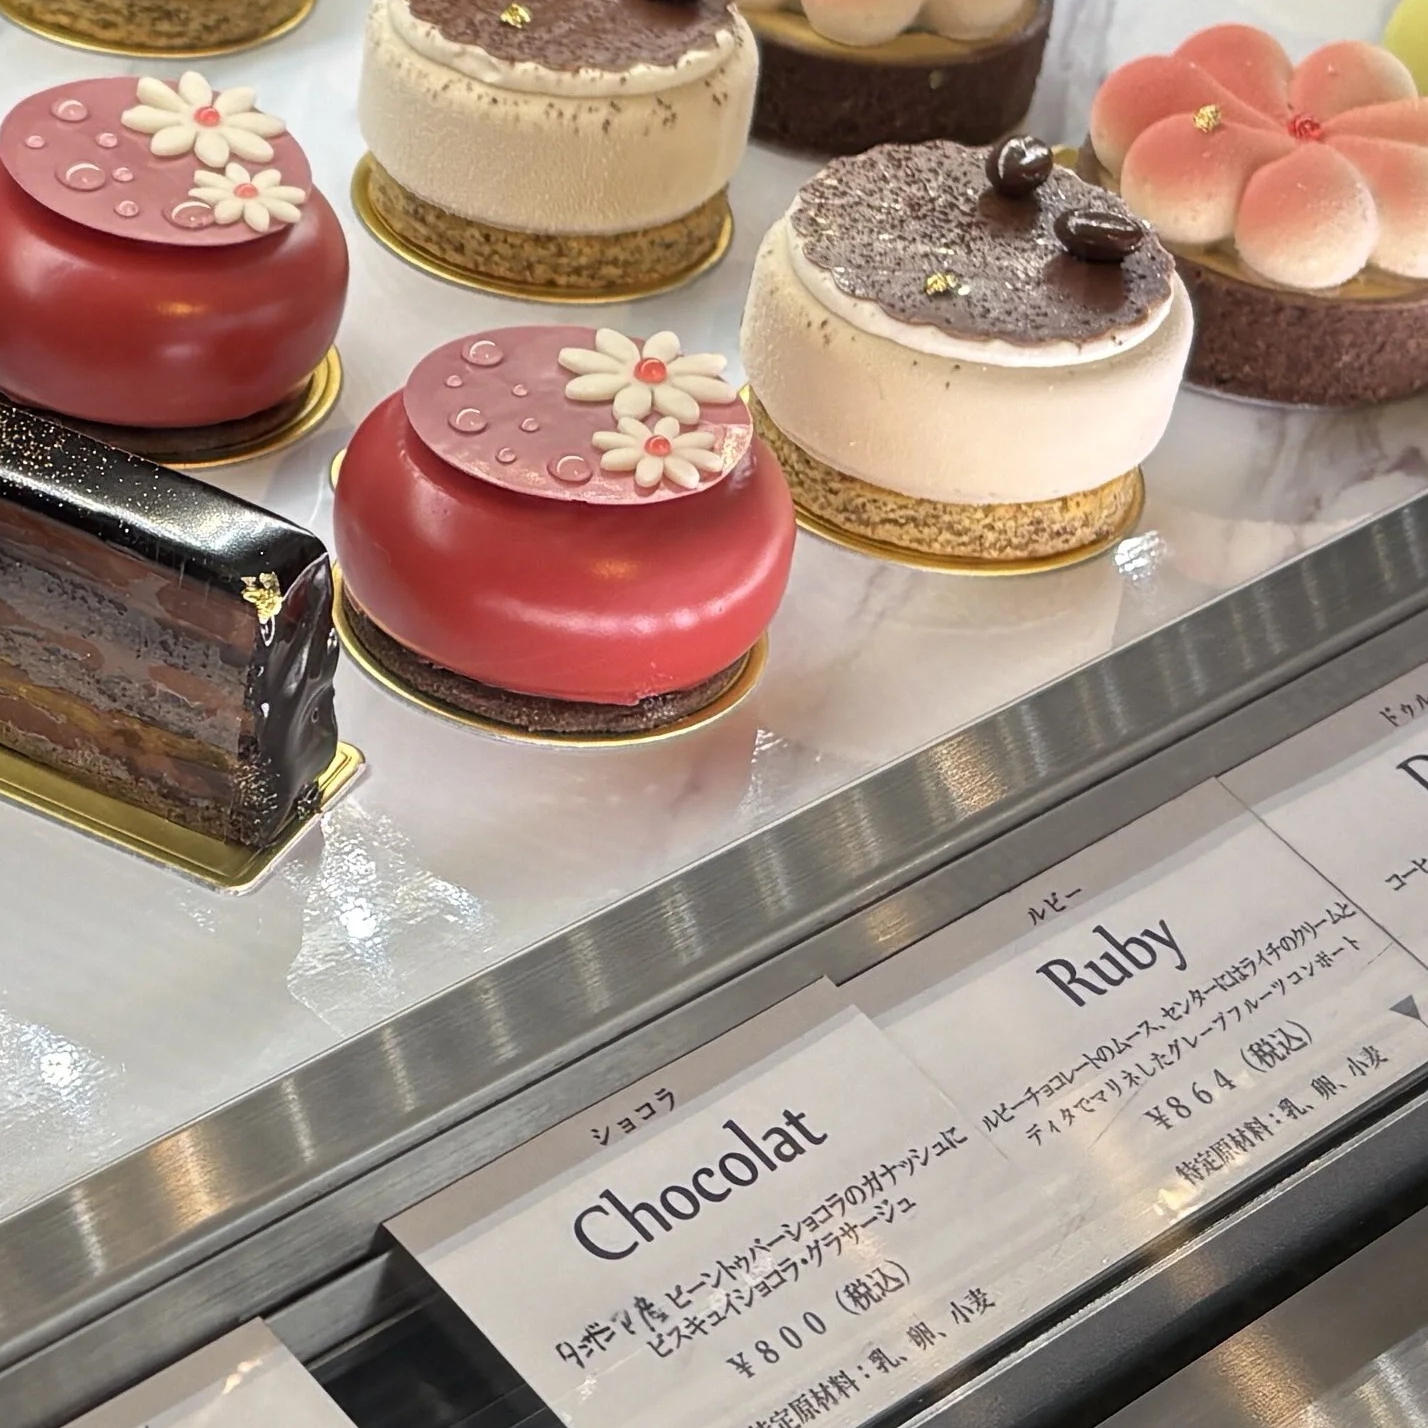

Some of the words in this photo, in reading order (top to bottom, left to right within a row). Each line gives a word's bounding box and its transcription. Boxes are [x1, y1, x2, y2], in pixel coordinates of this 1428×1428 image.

[1027, 888, 1084, 926] ルビー
[1036, 918, 1188, 1008] Ruby
[591, 1088, 678, 1148] ショコラ
[573, 1107, 829, 1261] Chocolat
